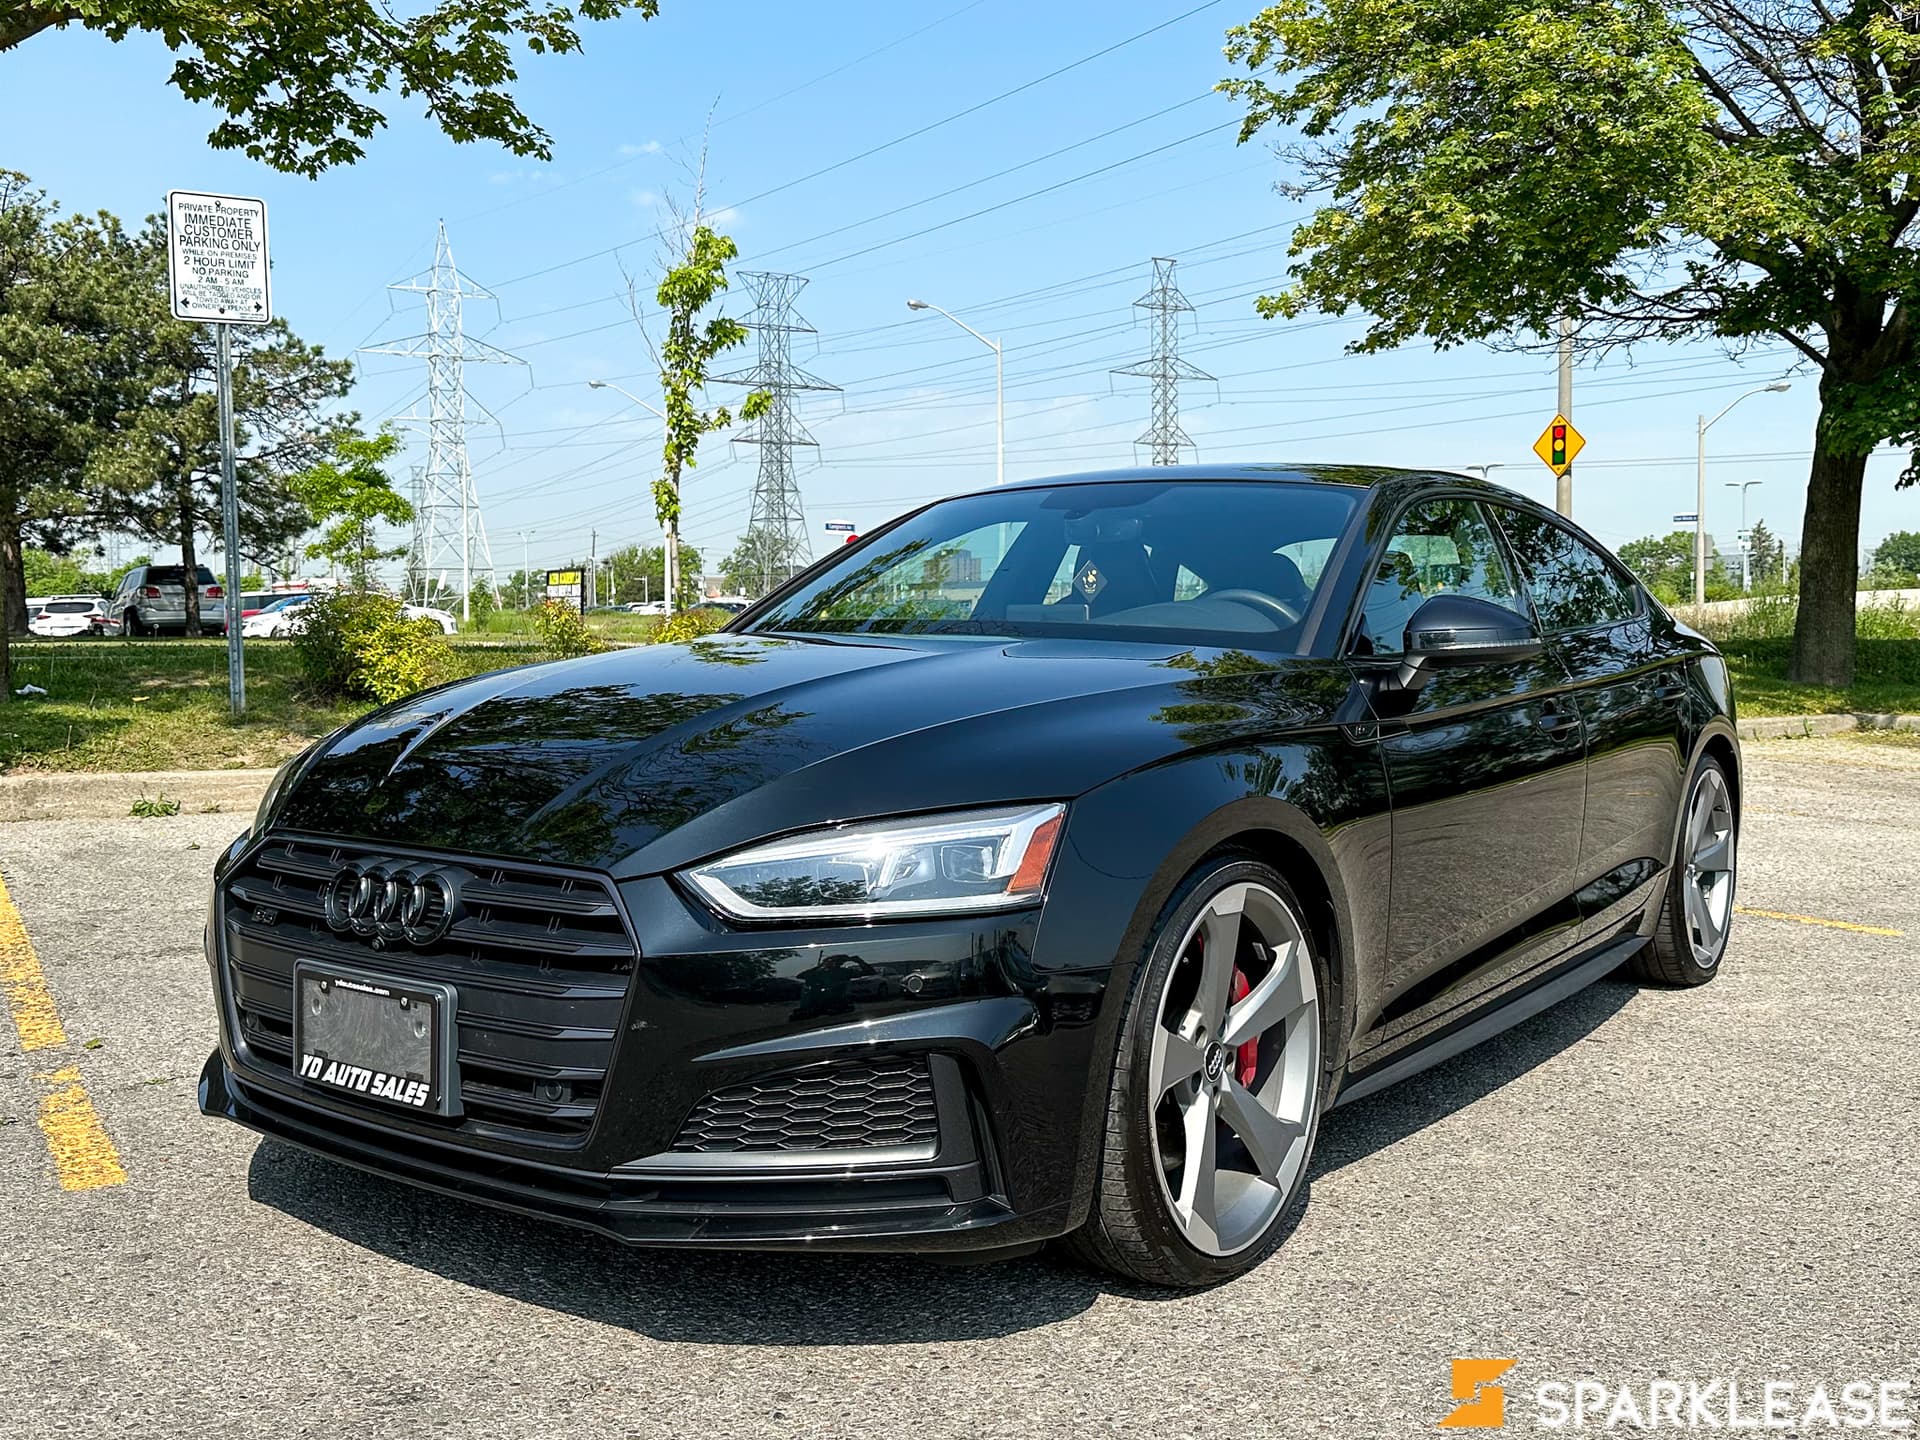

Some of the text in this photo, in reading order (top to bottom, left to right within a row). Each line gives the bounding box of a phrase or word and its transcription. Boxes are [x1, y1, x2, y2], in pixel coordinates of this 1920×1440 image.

[179, 203, 259, 217] PRIVATE PROPERTY
[185, 213, 251, 229] IMMEDIATE
[184, 224, 253, 240] CUSTOMER
[179, 234, 260, 252] PARKING ONLY
[182, 248, 257, 260] WHILE ON PREMISES
[184, 256, 256, 270] 2 HOUR LIMIT
[192, 266, 249, 278] NO PARKING
[205, 276, 218, 284] AM
[179, 283, 262, 294] UNAUTHORIZED VEHICLES
[300, 1054, 430, 1107] YD AUTO SALES
